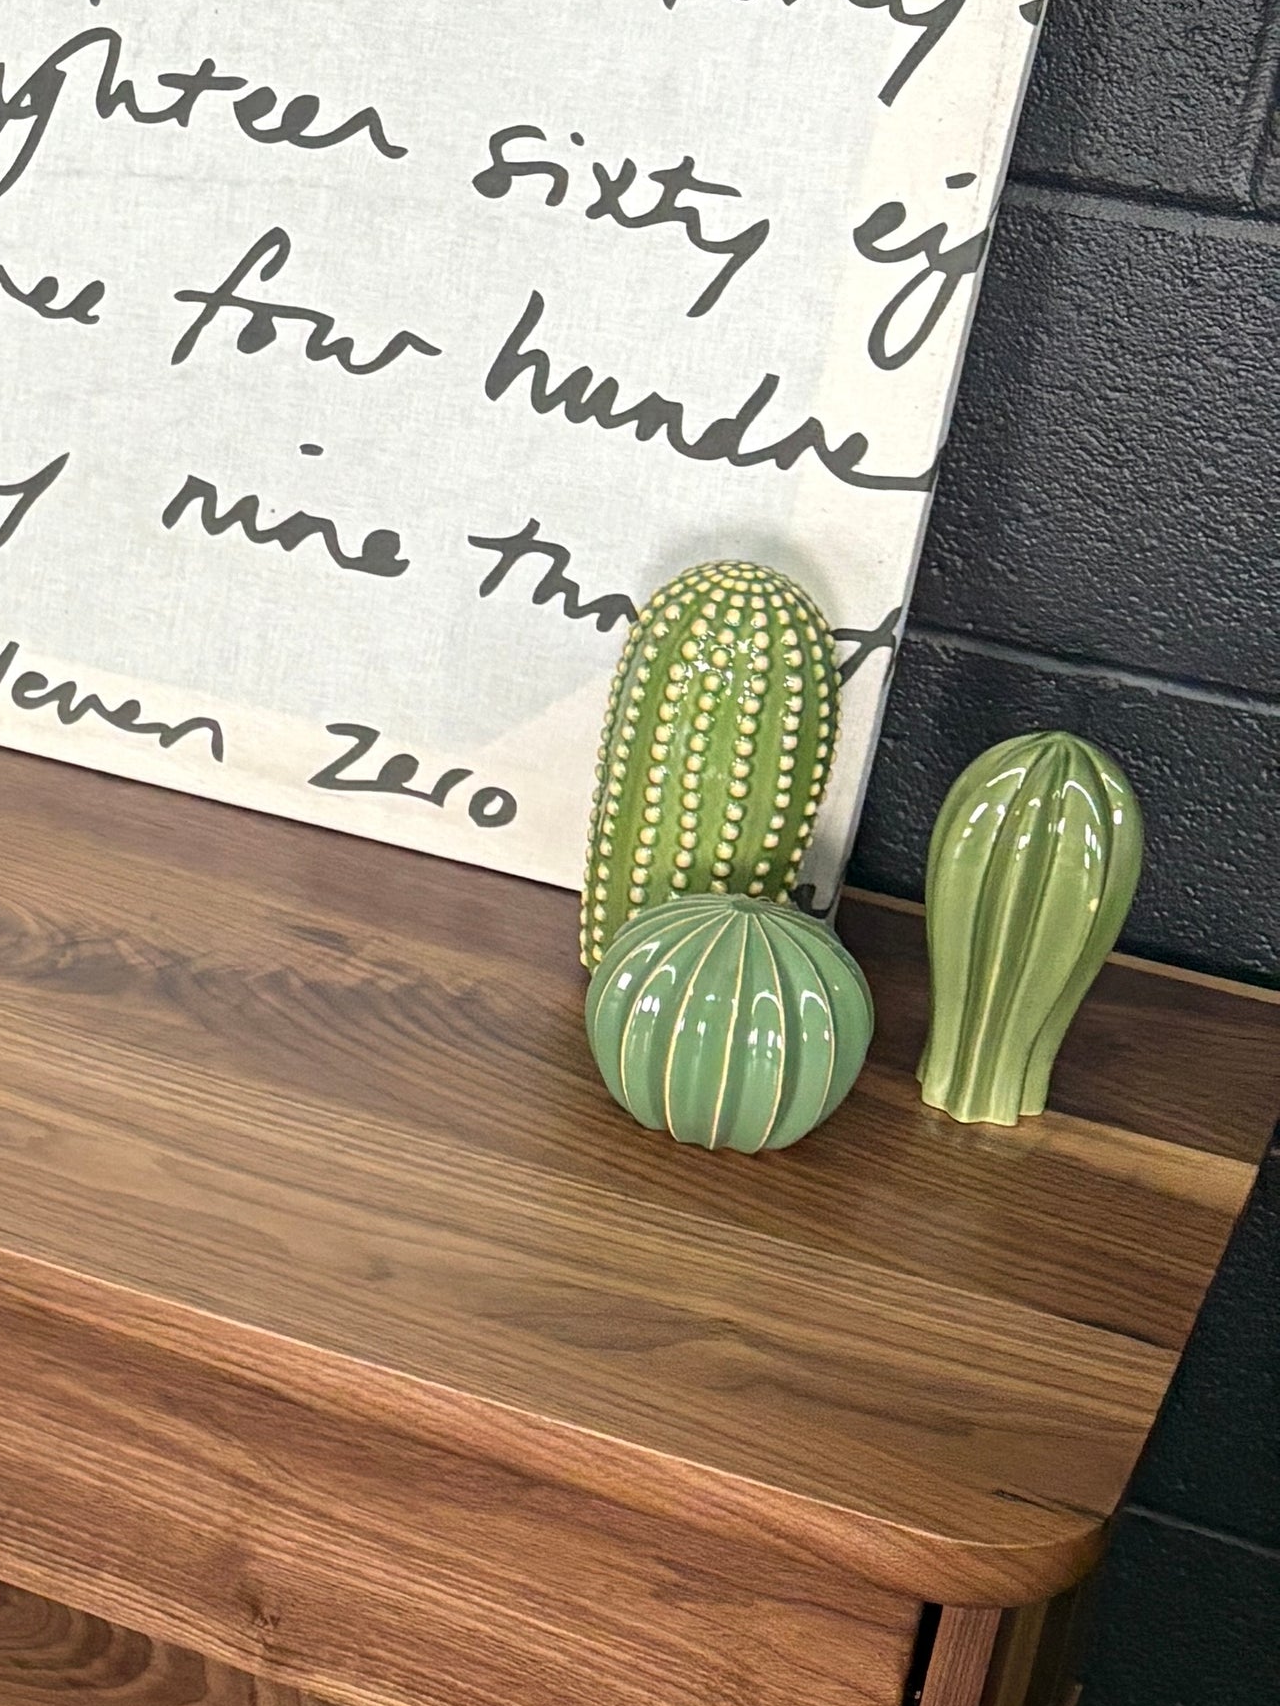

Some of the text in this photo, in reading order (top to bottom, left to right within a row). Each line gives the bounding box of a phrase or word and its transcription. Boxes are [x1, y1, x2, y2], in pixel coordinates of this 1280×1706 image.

[471, 123, 771, 319] sixty
[170, 225, 443, 376] four
[483, 291, 938, 493] hundre
[161, 442, 411, 578] nine
[307, 722, 518, 829] zero
